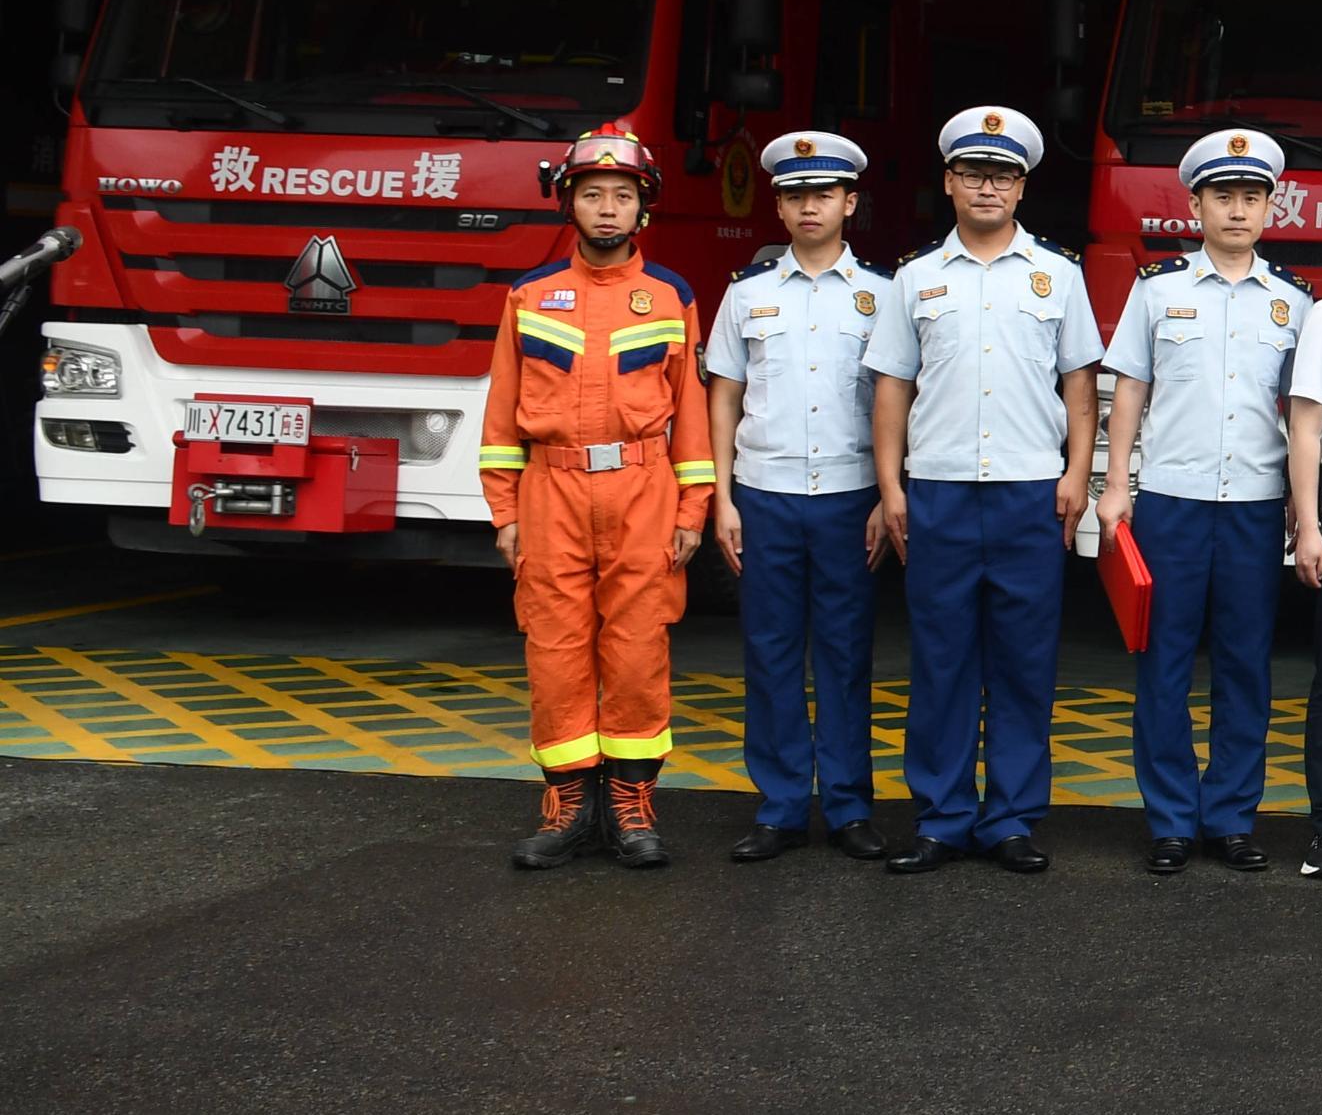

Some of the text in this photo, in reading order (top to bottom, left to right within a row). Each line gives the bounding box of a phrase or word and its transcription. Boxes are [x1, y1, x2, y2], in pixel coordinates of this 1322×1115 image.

[210, 145, 463, 200] 救 RESCUE 援
[98, 177, 182, 194] HOWO
[458, 213, 499, 227] 310
[1141, 217, 1204, 235] HOW
[553, 289, 576, 301] 119
[291, 299, 346, 311] CNHTC
